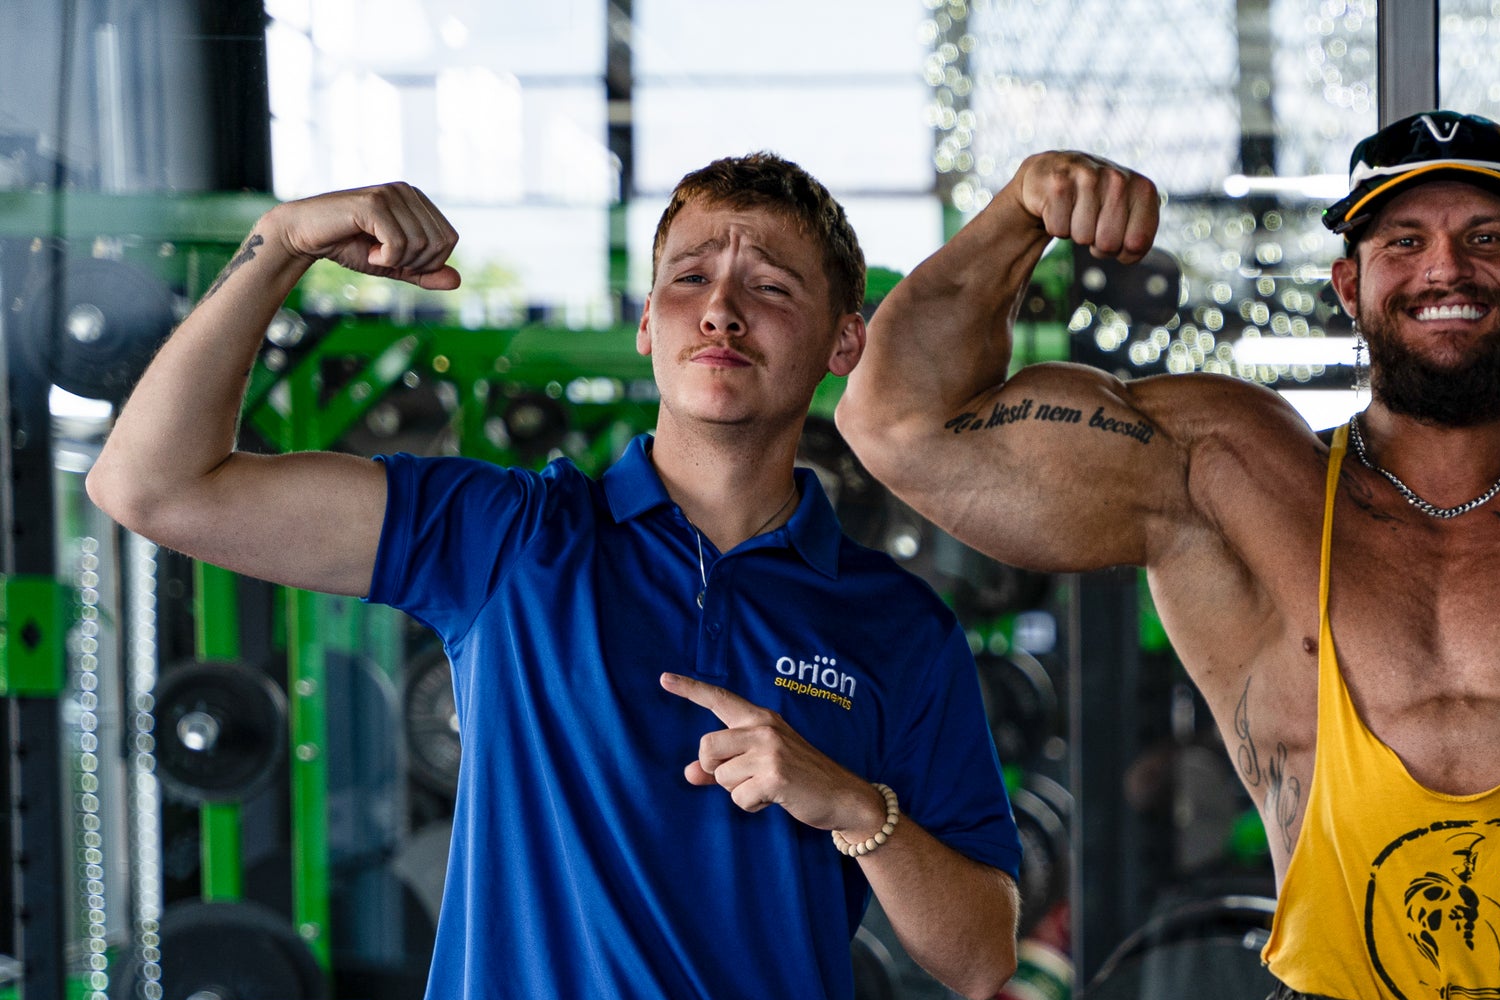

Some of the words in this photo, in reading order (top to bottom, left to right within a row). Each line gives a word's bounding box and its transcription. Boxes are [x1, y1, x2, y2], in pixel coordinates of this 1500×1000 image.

[1034, 403, 1082, 424] nem
[775, 655, 857, 697] oriön
[774, 677, 853, 711] supplements
